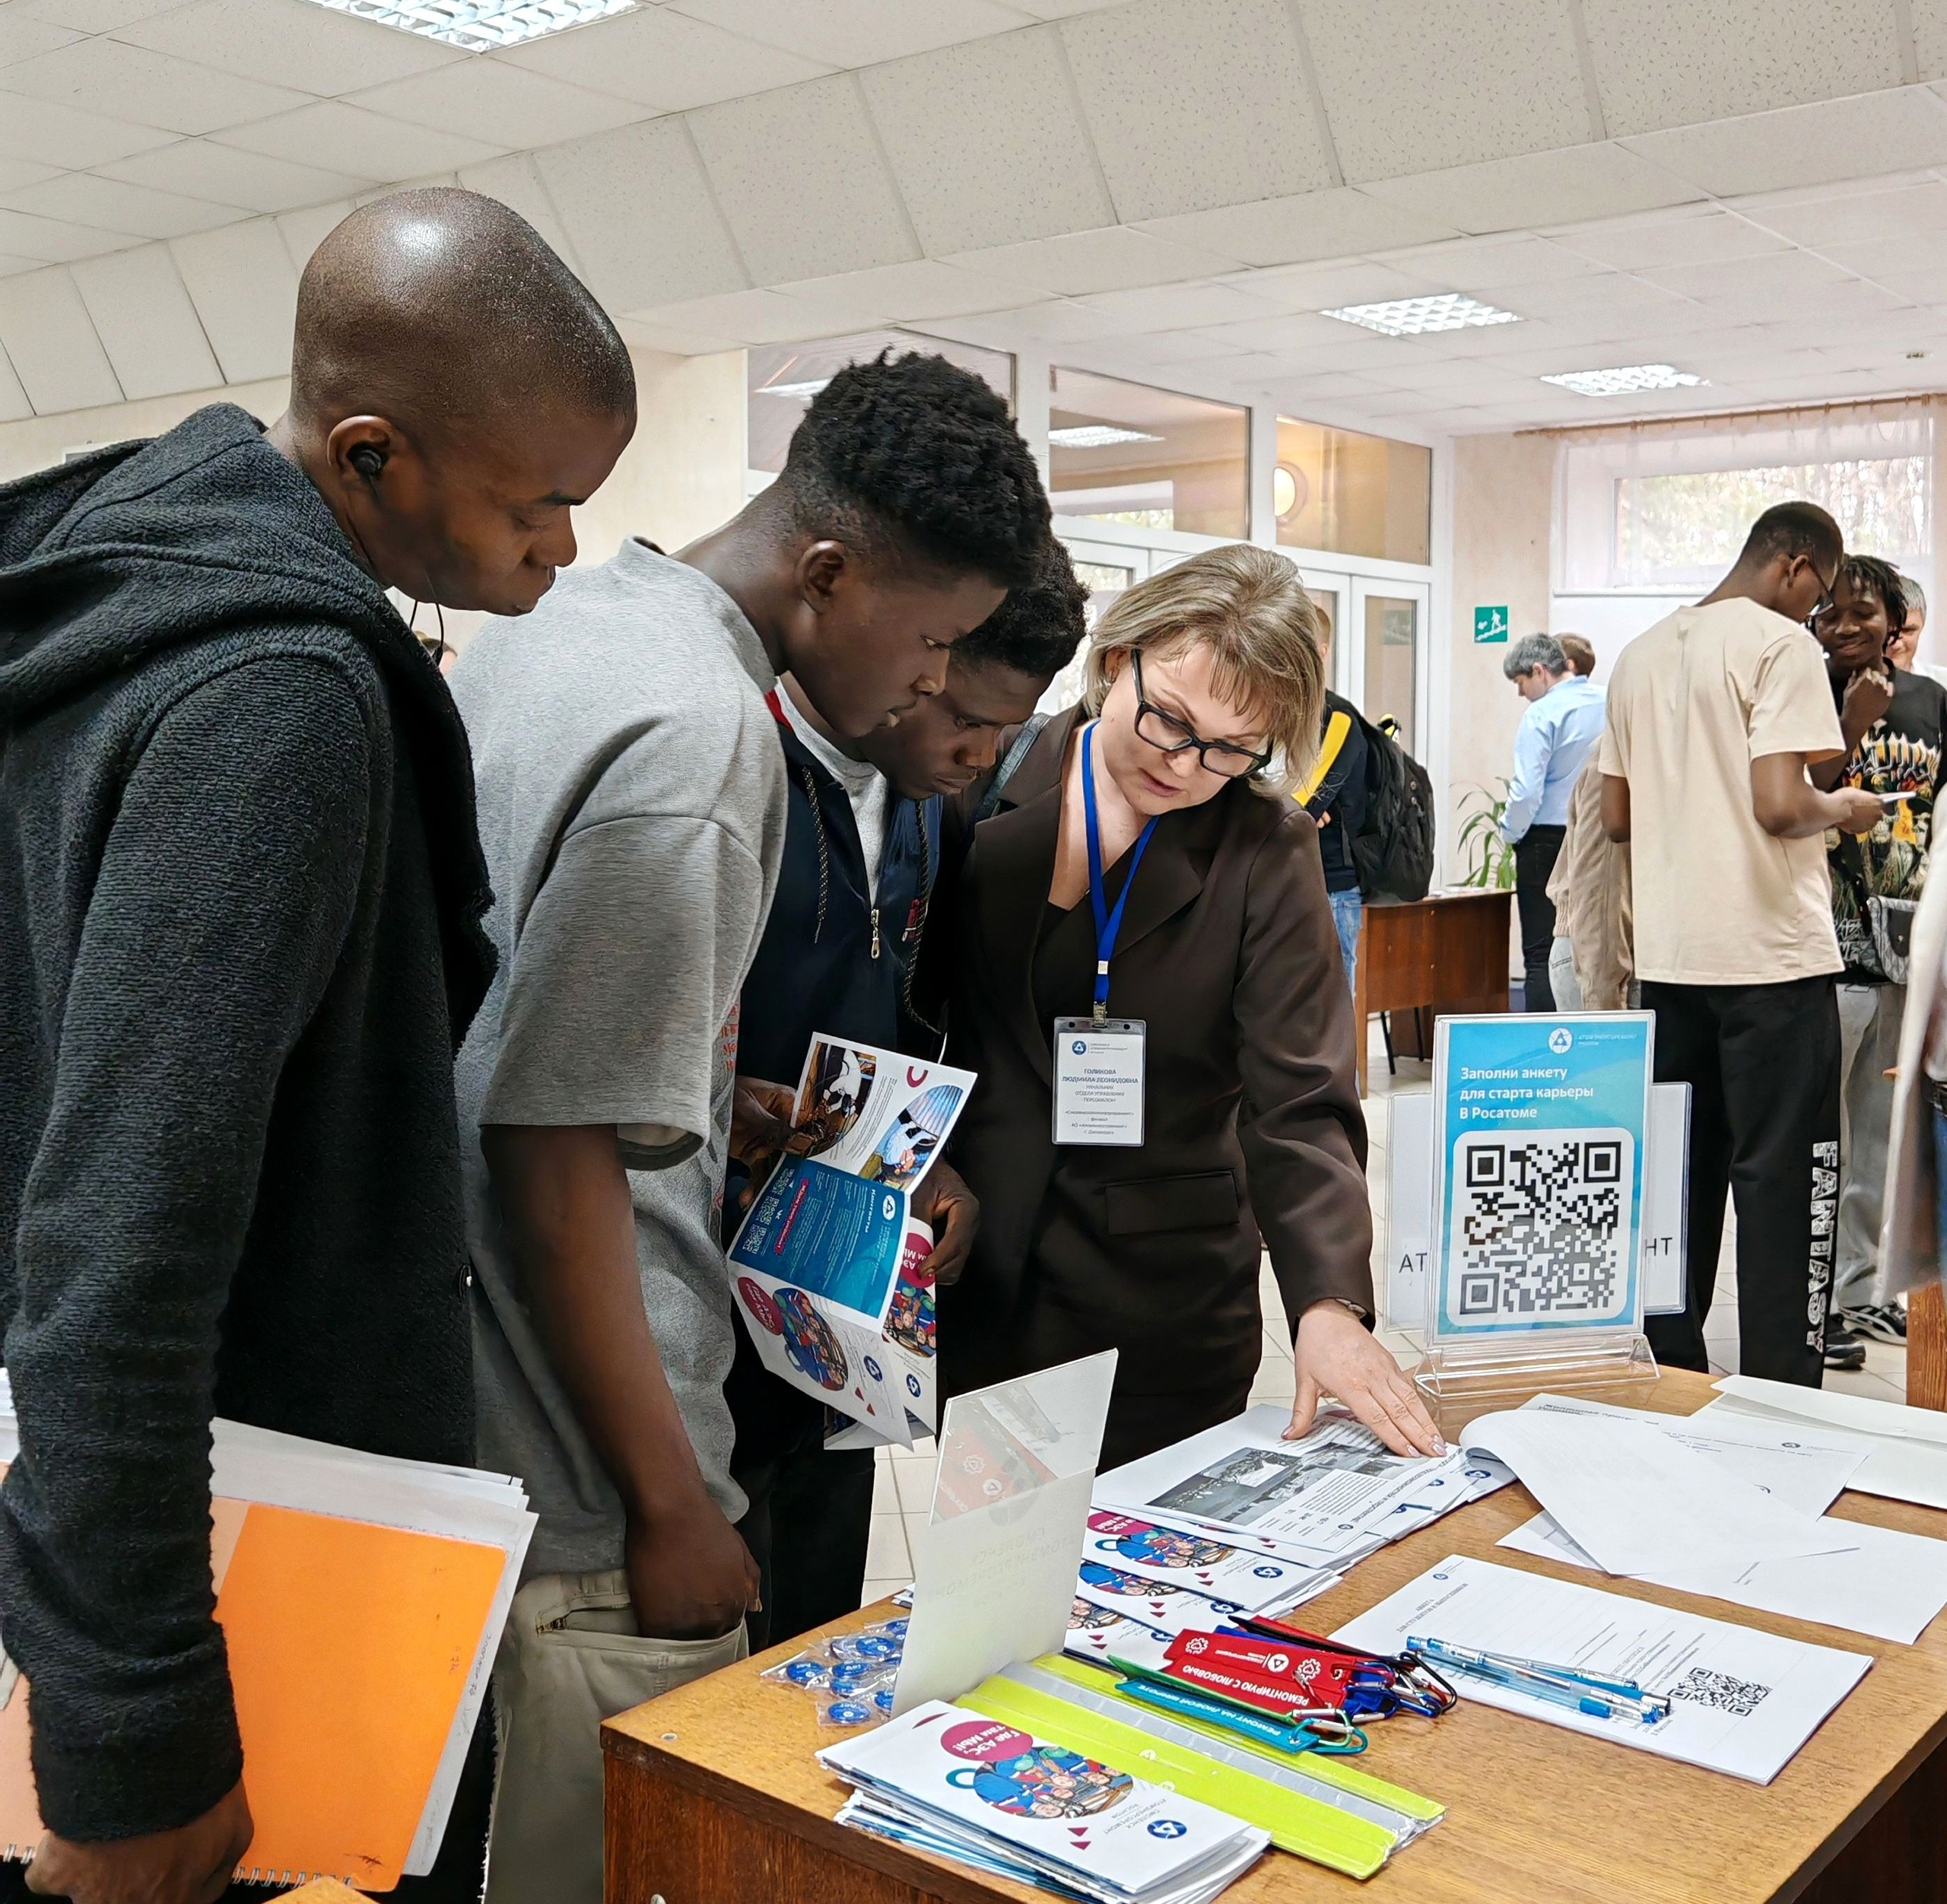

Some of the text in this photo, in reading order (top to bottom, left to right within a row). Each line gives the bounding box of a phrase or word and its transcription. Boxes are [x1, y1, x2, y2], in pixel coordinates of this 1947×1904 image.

[1460, 1066, 1568, 1081] Заполни анкету
[1459, 1087, 1594, 1101] для старта карьеры
[1459, 1107, 1538, 1120] В Росатоме
[1182, 1664, 1310, 1707] РЕМОНТИРУЮ С ЛЮБОВЬЮ
[1220, 1706, 1236, 1718] НА
[979, 1724, 1005, 1737] там
[1234, 1711, 1282, 1737] РЕМОНТ
[963, 1730, 1021, 1756] Где АЭС,
